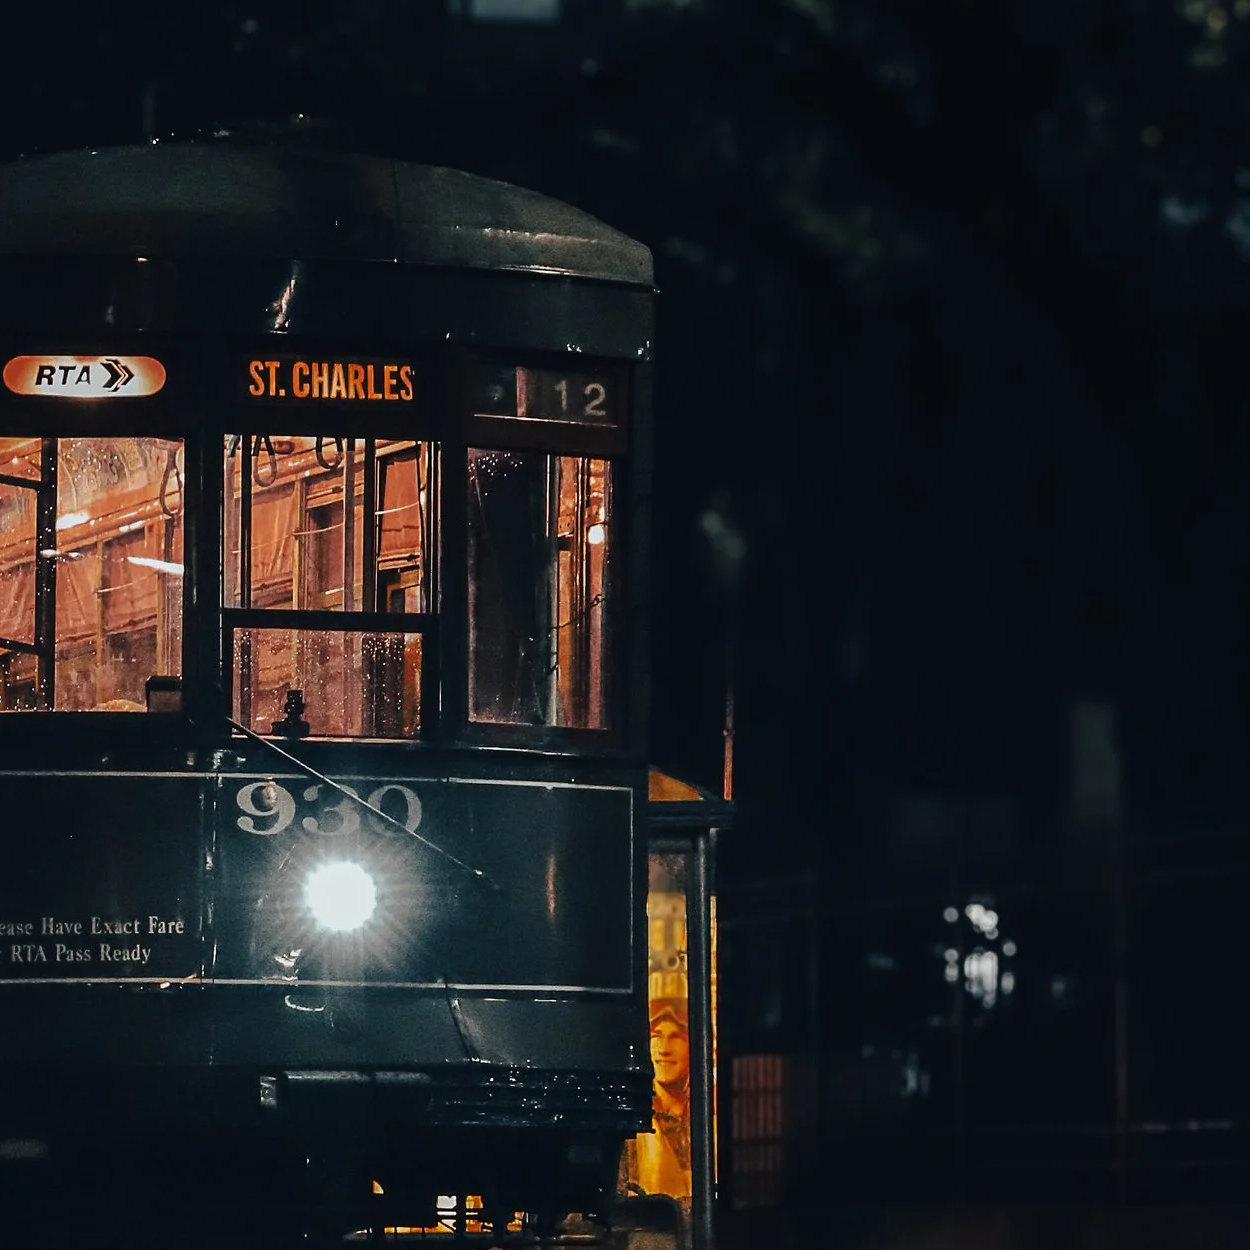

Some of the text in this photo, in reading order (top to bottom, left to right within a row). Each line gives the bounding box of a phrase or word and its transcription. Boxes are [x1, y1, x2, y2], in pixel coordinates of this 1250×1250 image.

[34, 364, 92, 386] RTA
[249, 360, 414, 401] ST. CHARLES
[553, 379, 607, 417] 12
[236, 780, 423, 837] 930
[41, 916, 83, 935] Have
[91, 916, 141, 935] Exact
[148, 915, 185, 935] Fare
[11, 944, 48, 963] RTA
[55, 943, 92, 962] Pass
[100, 943, 151, 965] Ready
